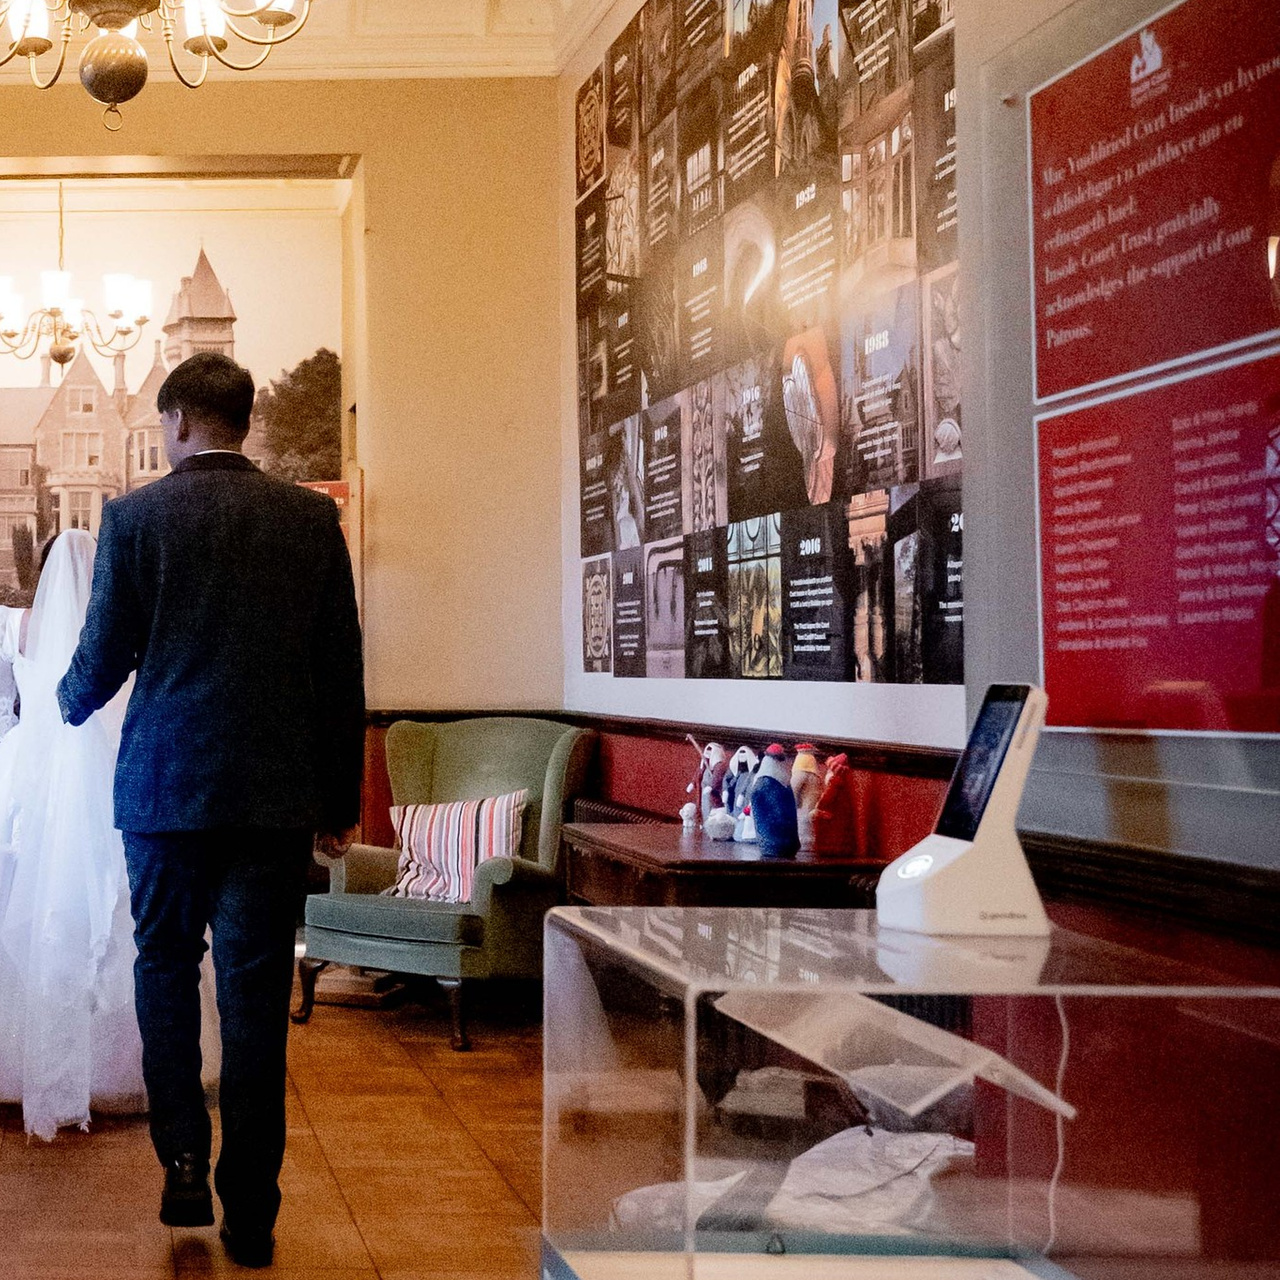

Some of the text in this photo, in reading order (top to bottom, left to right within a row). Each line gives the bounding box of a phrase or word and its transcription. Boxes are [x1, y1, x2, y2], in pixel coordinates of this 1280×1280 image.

[1133, 112, 1167, 142] Cwrt
[1169, 87, 1212, 124] Insole
[1045, 195, 1220, 285] Insole Court Trust gratefully
[1045, 224, 1254, 317] acknowledges the support of our
[800, 537, 821, 556] 2016
